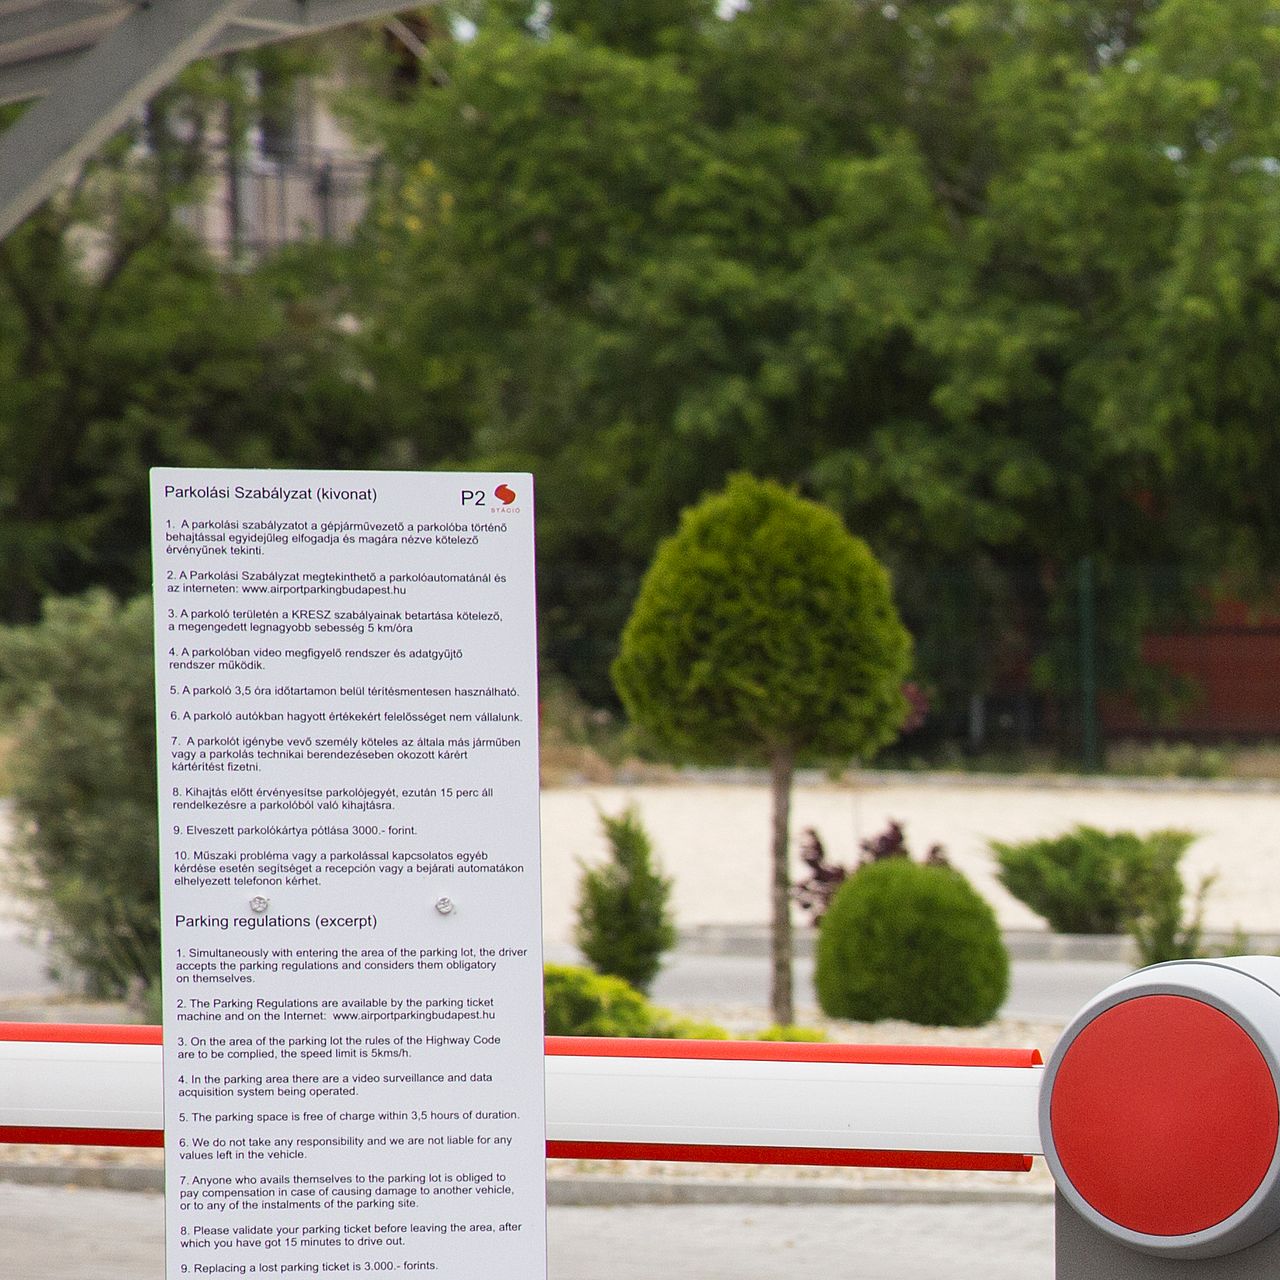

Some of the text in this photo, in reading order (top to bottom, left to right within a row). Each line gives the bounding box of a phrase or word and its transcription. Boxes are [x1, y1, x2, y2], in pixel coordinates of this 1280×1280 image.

[164, 485, 377, 503] Parkolási Szabályzat (kivonat)
[461, 489, 486, 507] P2
[166, 570, 176, 580] 2.
[178, 570, 187, 580] A
[189, 570, 238, 580] Parkolási
[241, 570, 299, 583] Szabályzat
[379, 574, 386, 582] a
[389, 572, 491, 584] parkolóautomatánál
[494, 573, 506, 582] és
[167, 583, 406, 597] az interneten: www.airportparkingbudapest.hu
[168, 621, 413, 635] a megengedett legnagyobb sebesség 5 km/óra
[169, 659, 215, 669] rendszer
[171, 761, 261, 771] kártérítést fizetni.
[172, 799, 247, 809] rendelkezésre
[259, 800, 314, 811] parkolóból
[316, 800, 339, 809] való
[172, 825, 183, 835] 9.
[186, 825, 234, 835] Elveszett
[237, 825, 308, 837] parkolókártya
[311, 825, 349, 837] pótlása
[388, 825, 417, 835] forint.
[174, 863, 216, 873] kérdése
[218, 863, 254, 873] esetén
[257, 863, 312, 875] segítséget
[324, 863, 375, 875] recepción
[378, 865, 404, 875] vagy
[416, 863, 454, 875] bejárati
[457, 863, 524, 873] automatákon
[174, 876, 231, 888] elhelyezett
[233, 875, 282, 886] telefonon
[175, 914, 377, 930] Parking regulations (excerpt)
[176, 947, 527, 959] 1. Simultaneously with entering the area of the parking lot, the driver
[175, 959, 496, 972] accepts the parking regulations and considers them obligatory
[176, 973, 255, 983] on themselves.
[176, 997, 494, 1011] 2. The Parking Regulations are available by the parking ticket
[176, 1011, 221, 1021] machine
[224, 1011, 244, 1020] and
[263, 1009, 280, 1020] the
[283, 1011, 326, 1020] Internet:
[332, 1010, 495, 1022] www.airportparkingbudapest.hu
[177, 1048, 411, 1060] are to be complied, the speed limit is 5kms/h.
[178, 1086, 358, 1098] acquisition system being operated.
[179, 1149, 307, 1160] values left in the vehicle.
[179, 1198, 418, 1212] or to any of the instalments of the parking site.
[180, 1236, 405, 1250] which you have got 15 minutes to drive out.
[180, 1263, 190, 1273] 9.
[194, 1263, 246, 1275] Replacing
[249, 1264, 256, 1272] a
[258, 1262, 278, 1272] lost
[280, 1262, 319, 1274] parking
[322, 1261, 350, 1271] ticket
[352, 1262, 361, 1271] is
[403, 1260, 438, 1270] forints.
